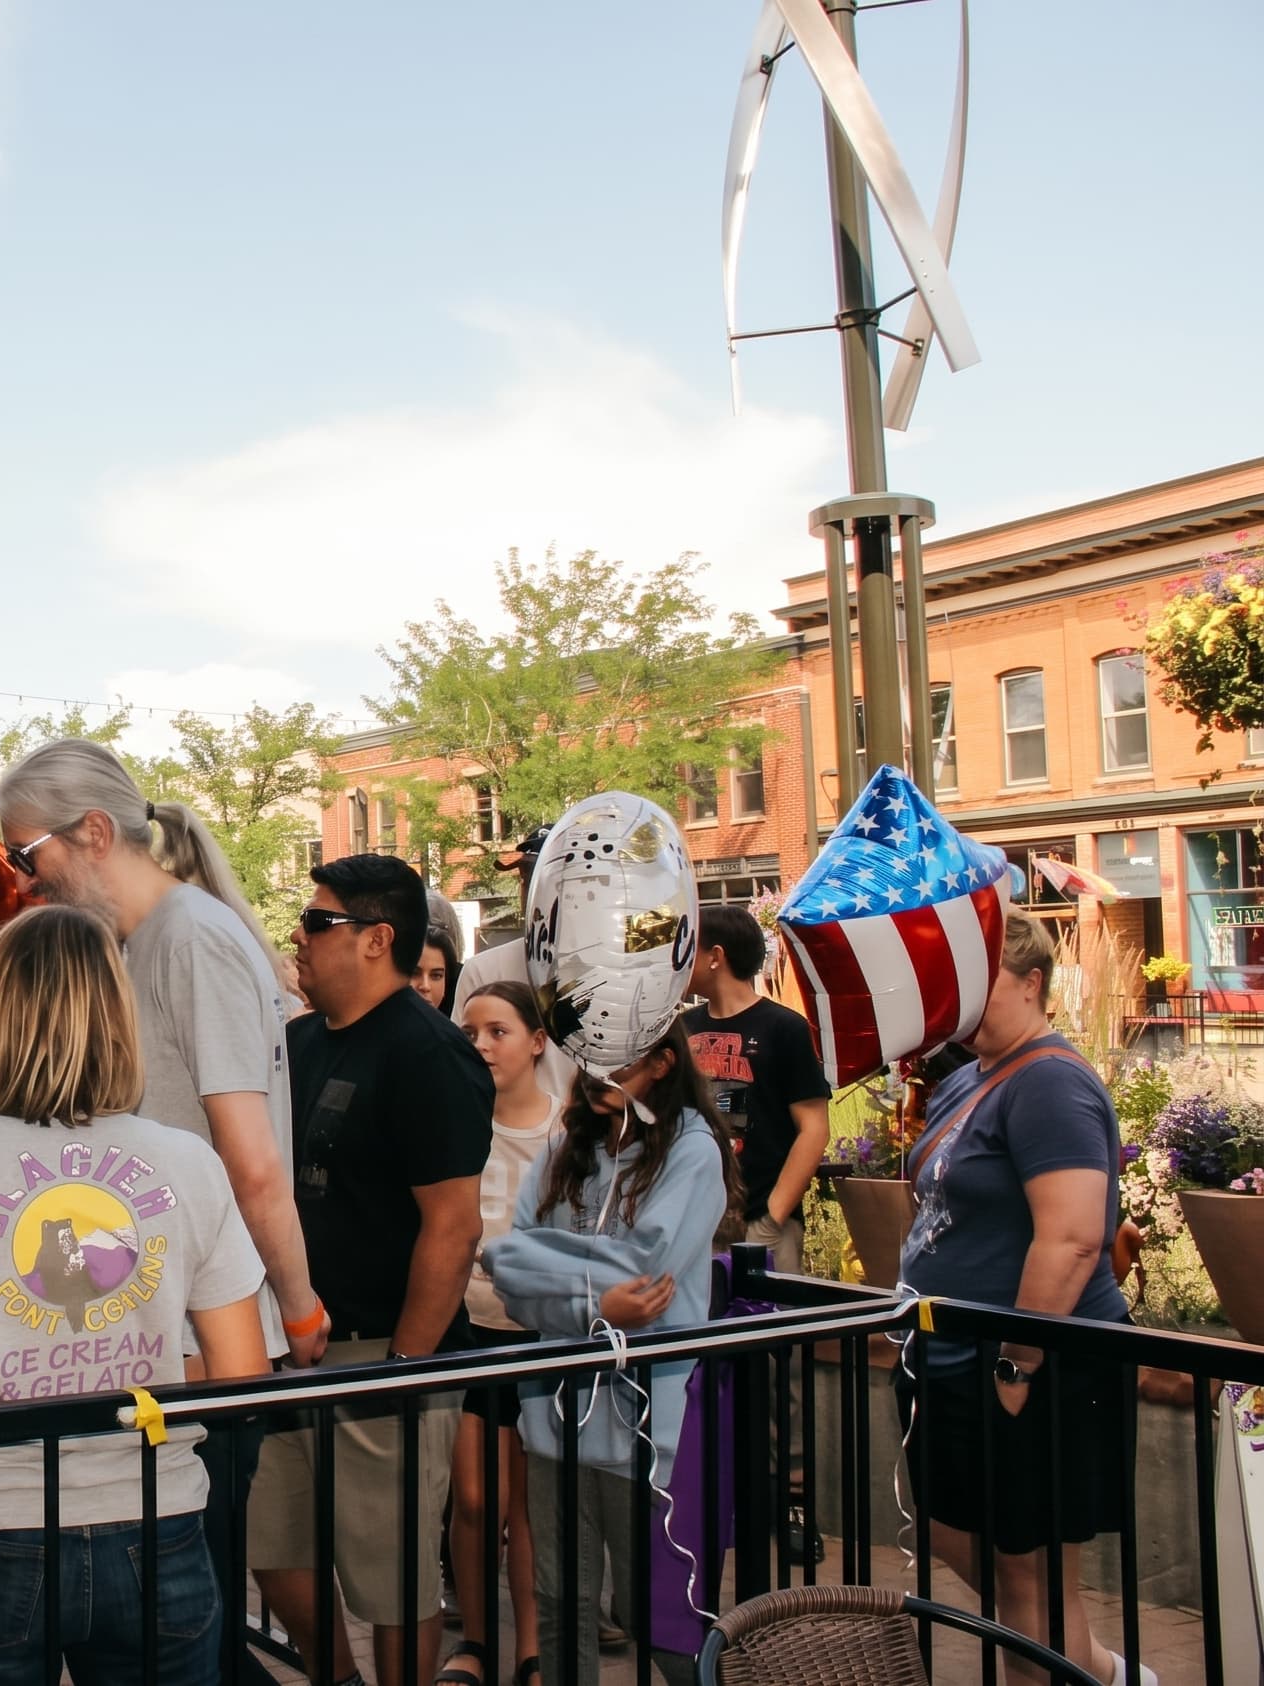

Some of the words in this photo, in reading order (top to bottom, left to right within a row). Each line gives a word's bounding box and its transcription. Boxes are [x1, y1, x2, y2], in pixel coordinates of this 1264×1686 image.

[48, 1332, 164, 1370] CREAM
[0, 1381, 22, 1402] &
[30, 1359, 155, 1399] GELATO
